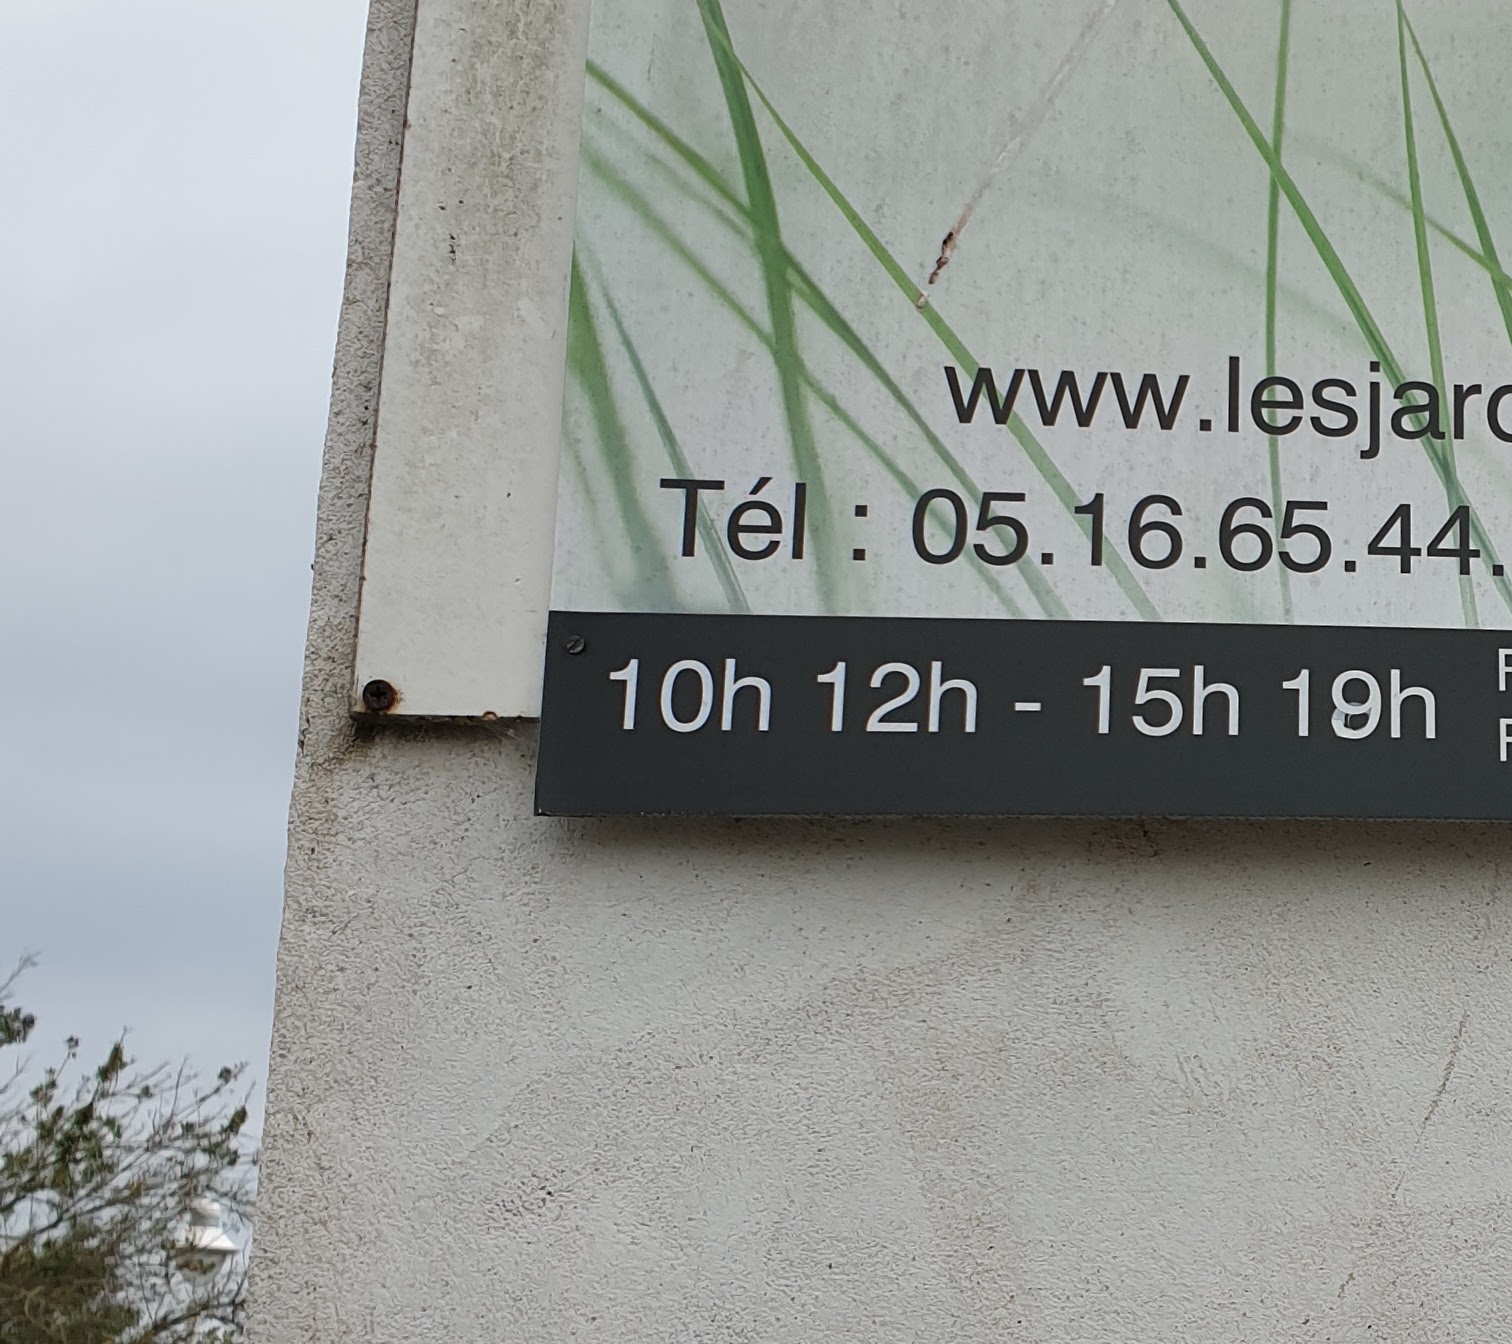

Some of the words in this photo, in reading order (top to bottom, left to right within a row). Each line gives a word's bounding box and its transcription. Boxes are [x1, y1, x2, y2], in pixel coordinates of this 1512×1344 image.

[659, 476, 807, 561] Tél
[850, 504, 869, 562] :
[607, 657, 773, 733] 10h
[815, 660, 978, 734] 12h
[1081, 665, 1241, 737] 15h
[1281, 668, 1438, 739] 19h
